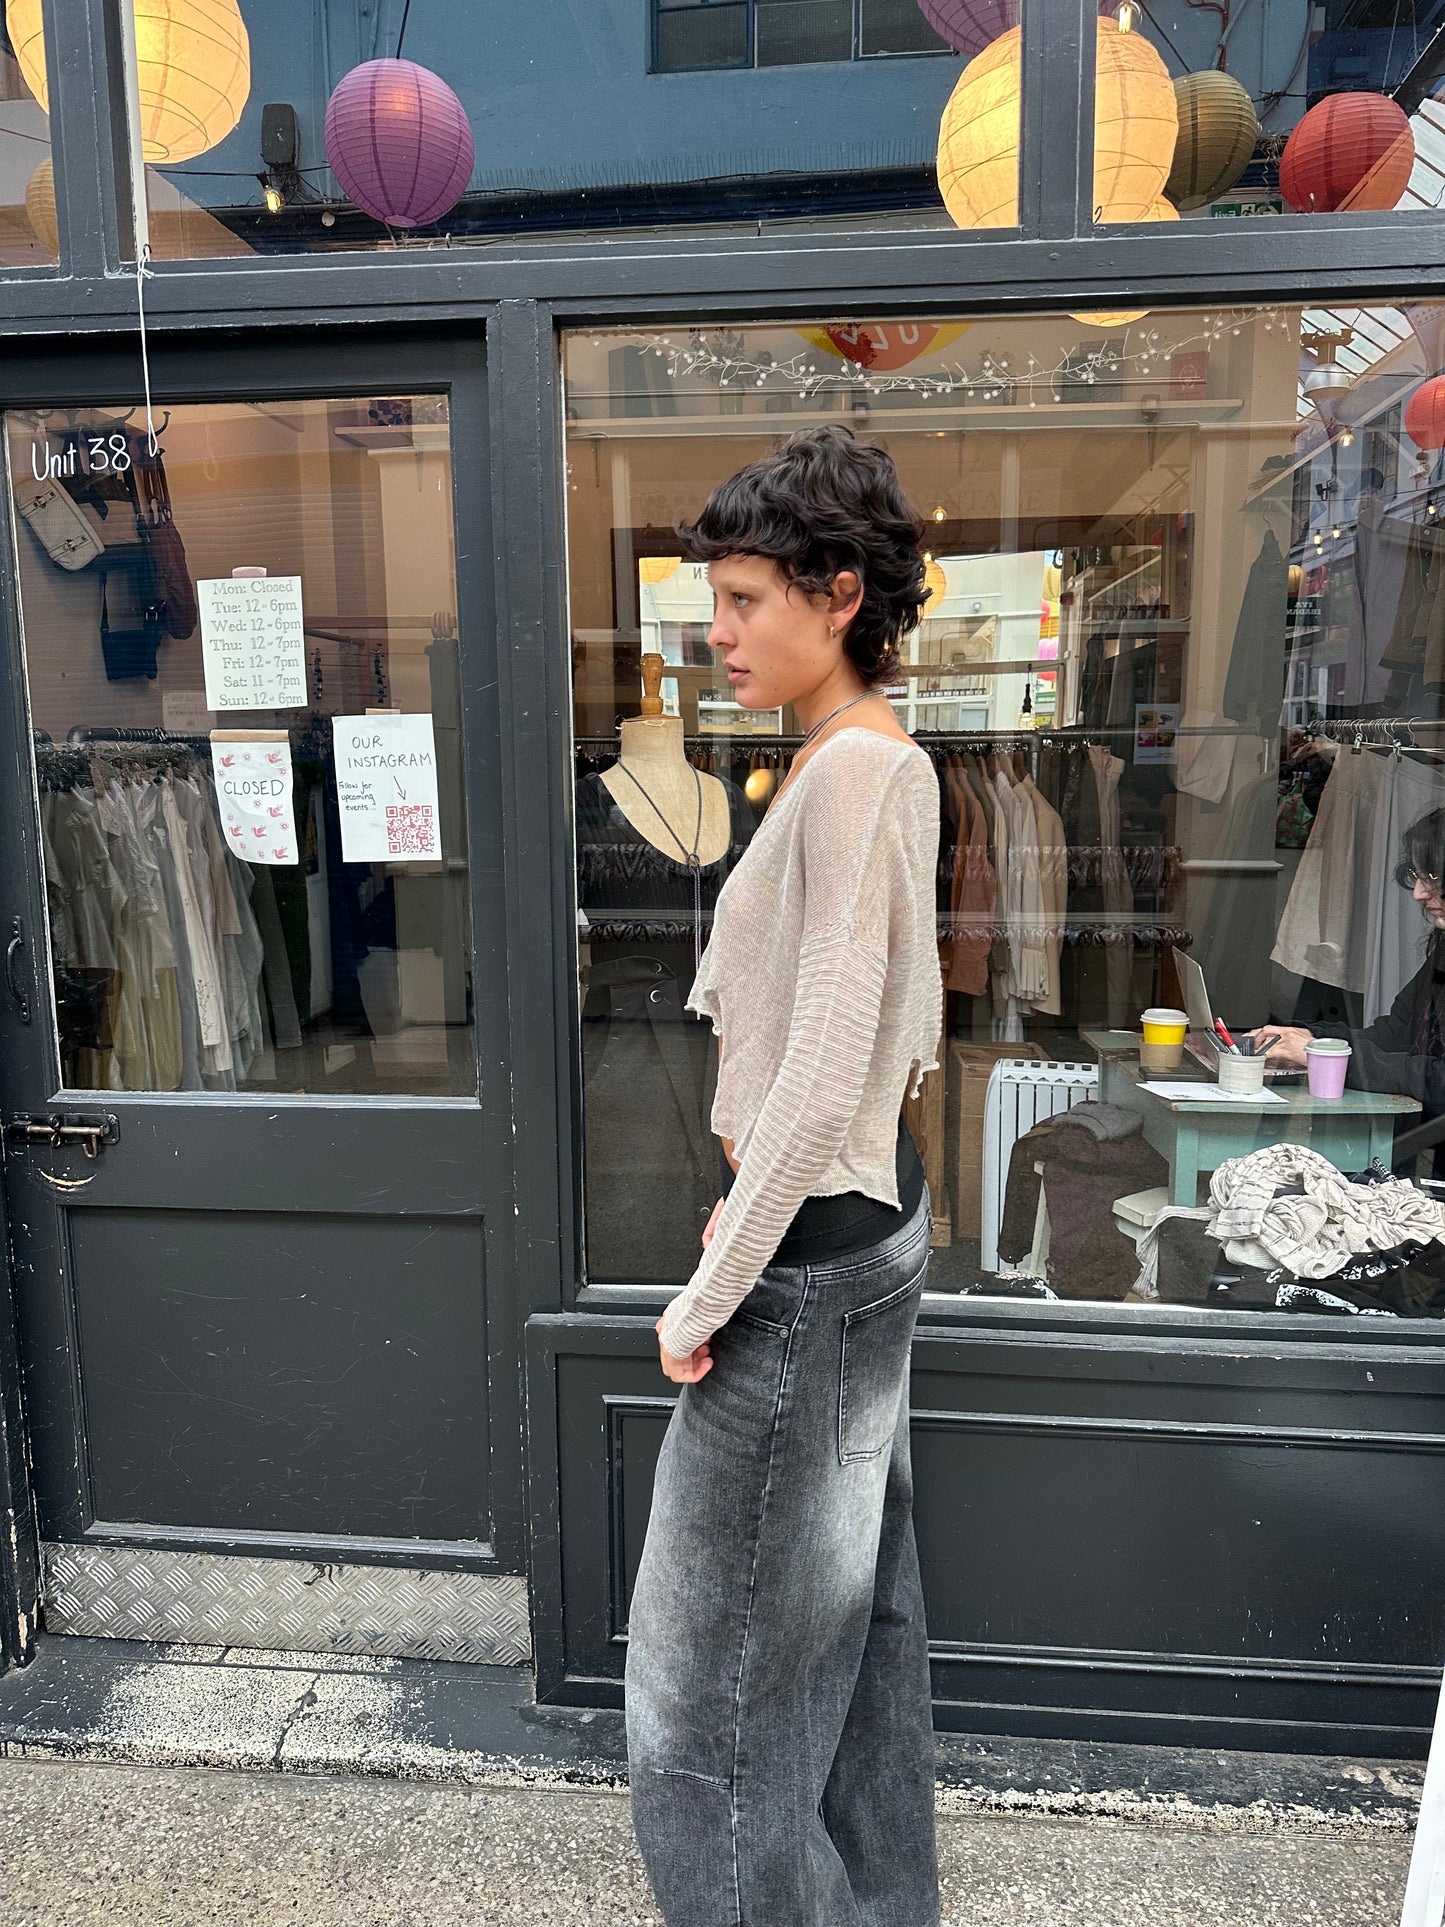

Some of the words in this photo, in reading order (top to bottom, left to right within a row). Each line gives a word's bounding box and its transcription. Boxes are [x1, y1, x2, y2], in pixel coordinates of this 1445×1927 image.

[31, 441, 77, 481] Unit
[87, 434, 131, 471] 38
[212, 582, 247, 596] Mon:
[250, 579, 294, 594] Closed
[211, 601, 241, 614] Tue:
[210, 619, 247, 633] Wed:
[209, 638, 242, 652] Thu:
[222, 656, 245, 669] Fri:
[223, 675, 248, 688] Sat:
[219, 693, 249, 707] Sun:
[351, 735, 384, 749] OUR
[347, 752, 433, 769] INSTAGRAM
[223, 779, 285, 797] CLOSED
[340, 793, 377, 806] upcoming
